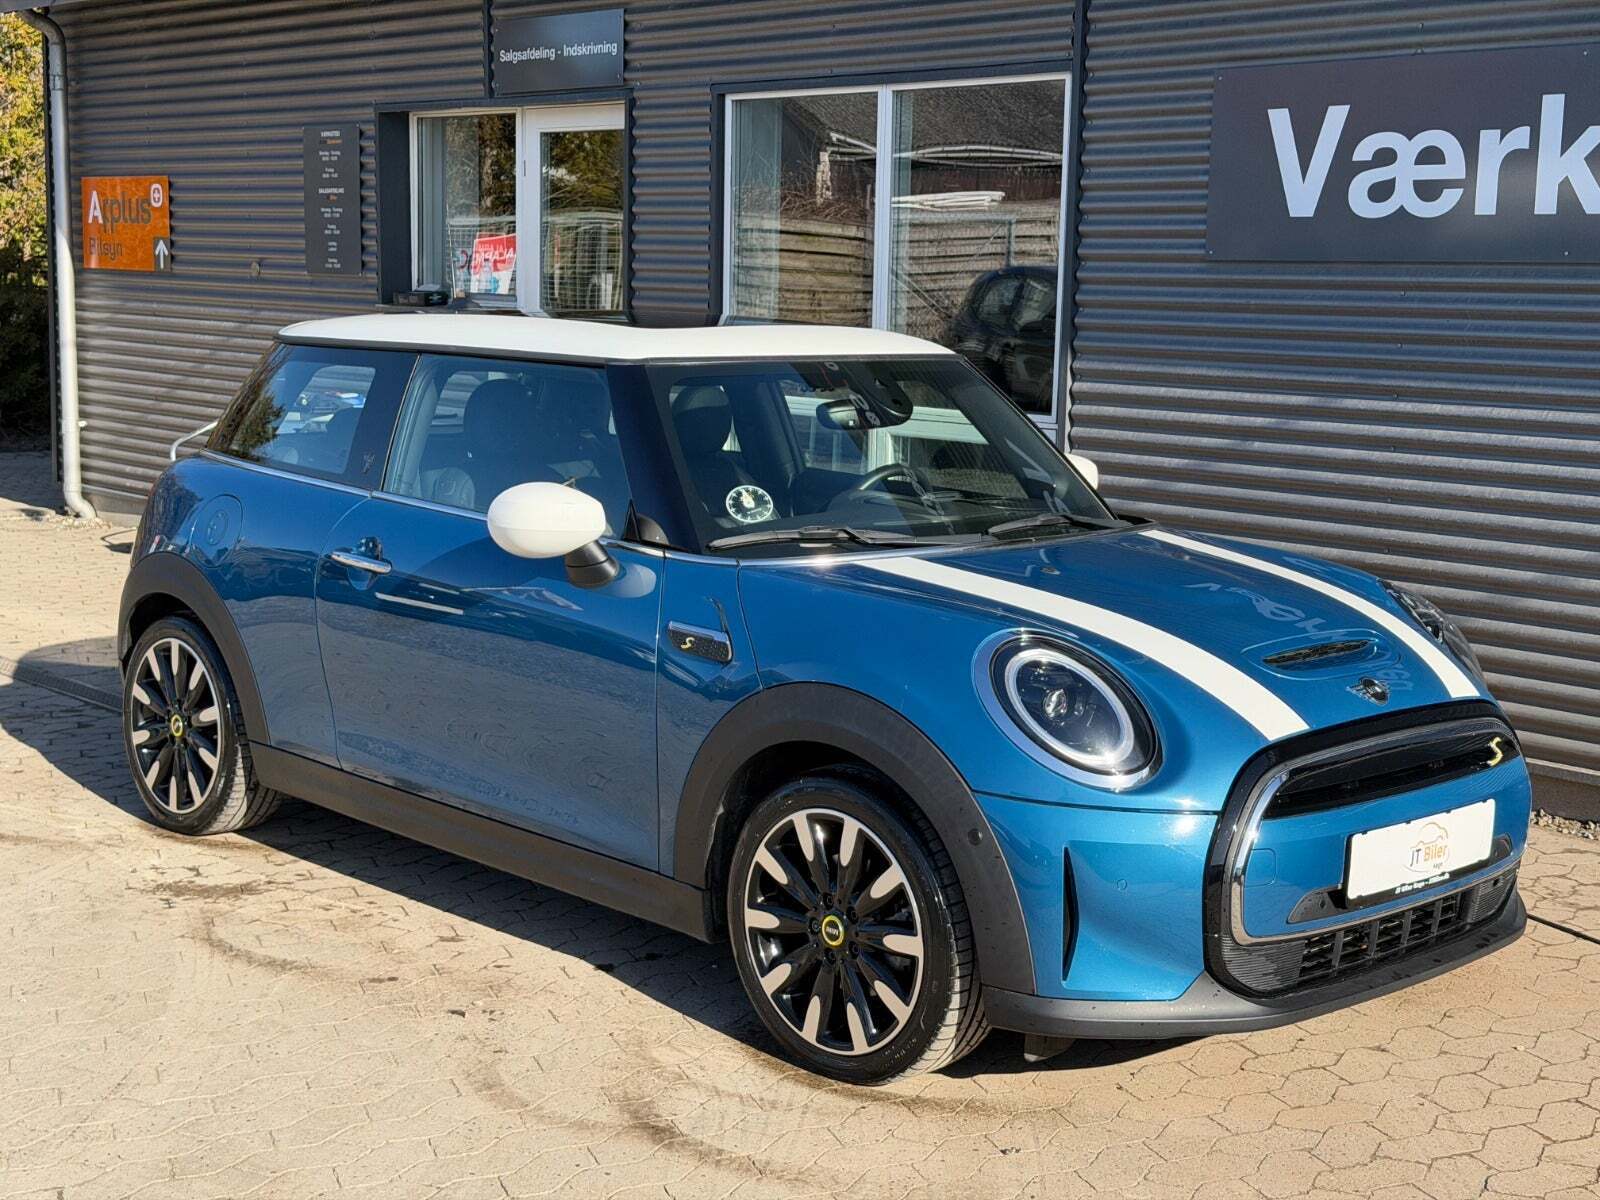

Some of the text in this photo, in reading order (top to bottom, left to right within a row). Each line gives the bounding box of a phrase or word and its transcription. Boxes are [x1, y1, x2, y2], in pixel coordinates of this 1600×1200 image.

[499, 47, 556, 63] Salgsafdeling
[563, 41, 617, 56] Indskrivning
[1267, 93, 1600, 218] Værk
[1410, 848, 1421, 867] JT
[1424, 844, 1447, 862] Biler
